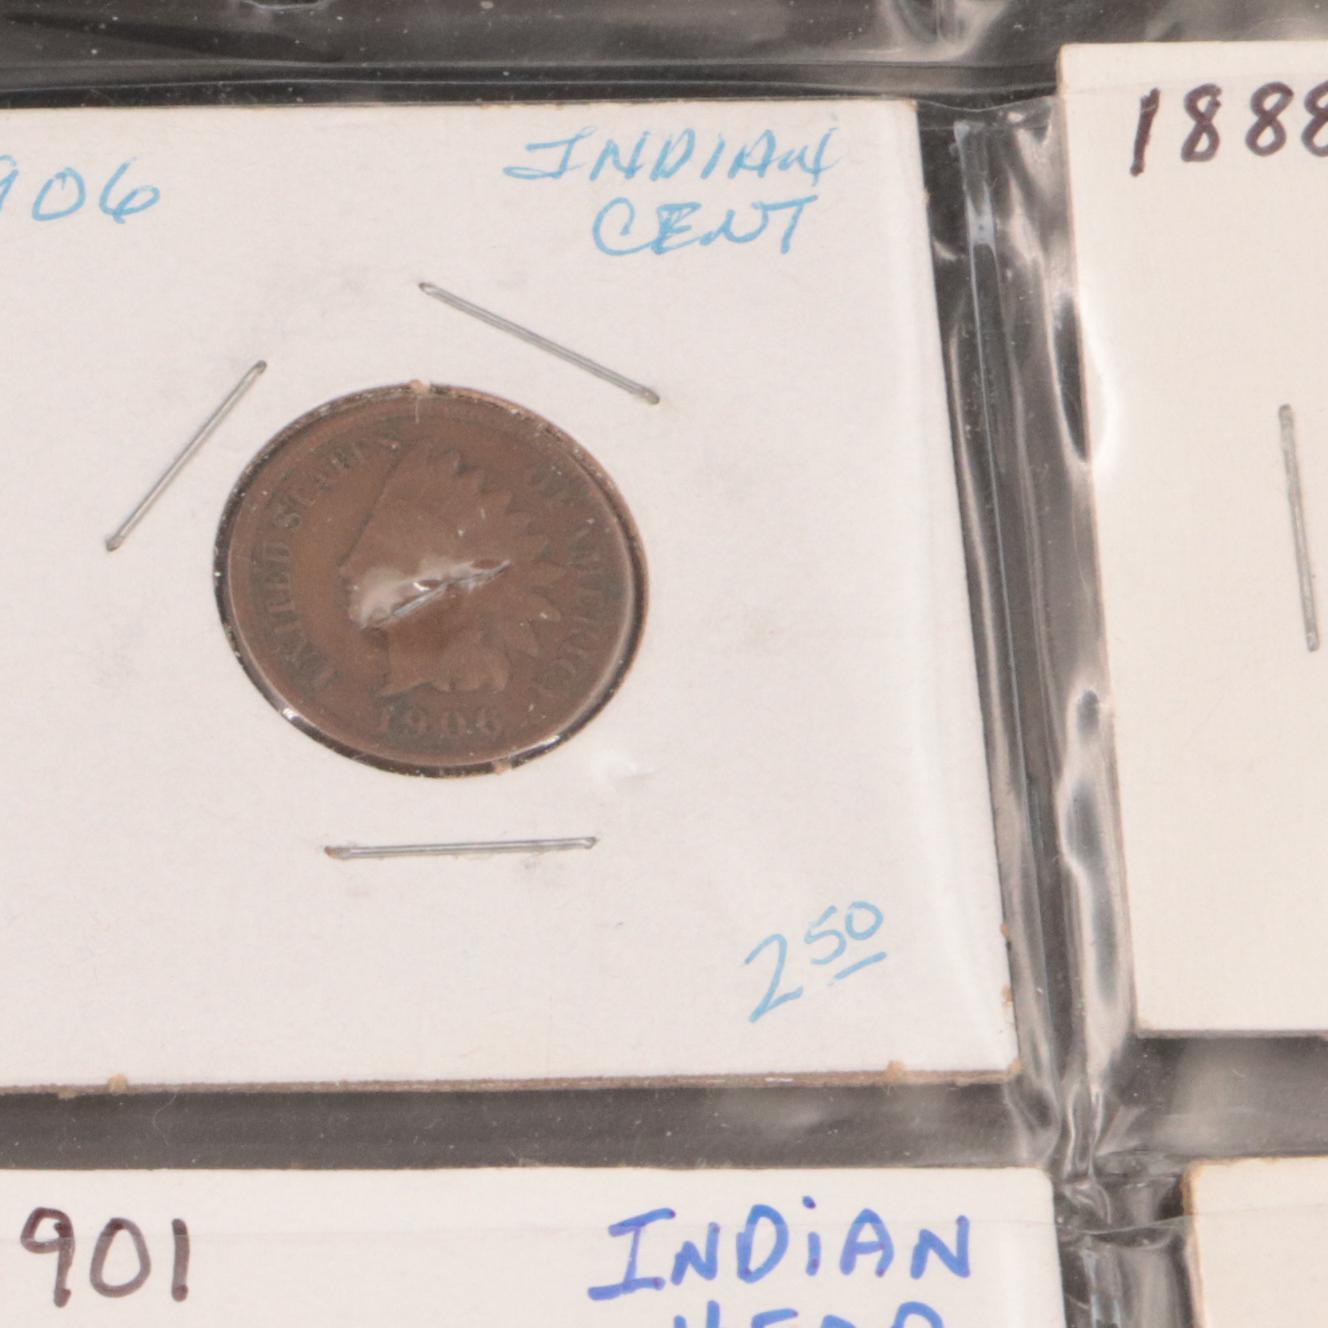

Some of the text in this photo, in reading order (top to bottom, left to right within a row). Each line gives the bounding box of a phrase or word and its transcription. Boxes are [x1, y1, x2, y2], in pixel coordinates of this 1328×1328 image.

[502, 125, 838, 188] INDIAN
[1130, 80, 1328, 177] 1888
[591, 195, 819, 257] CENT
